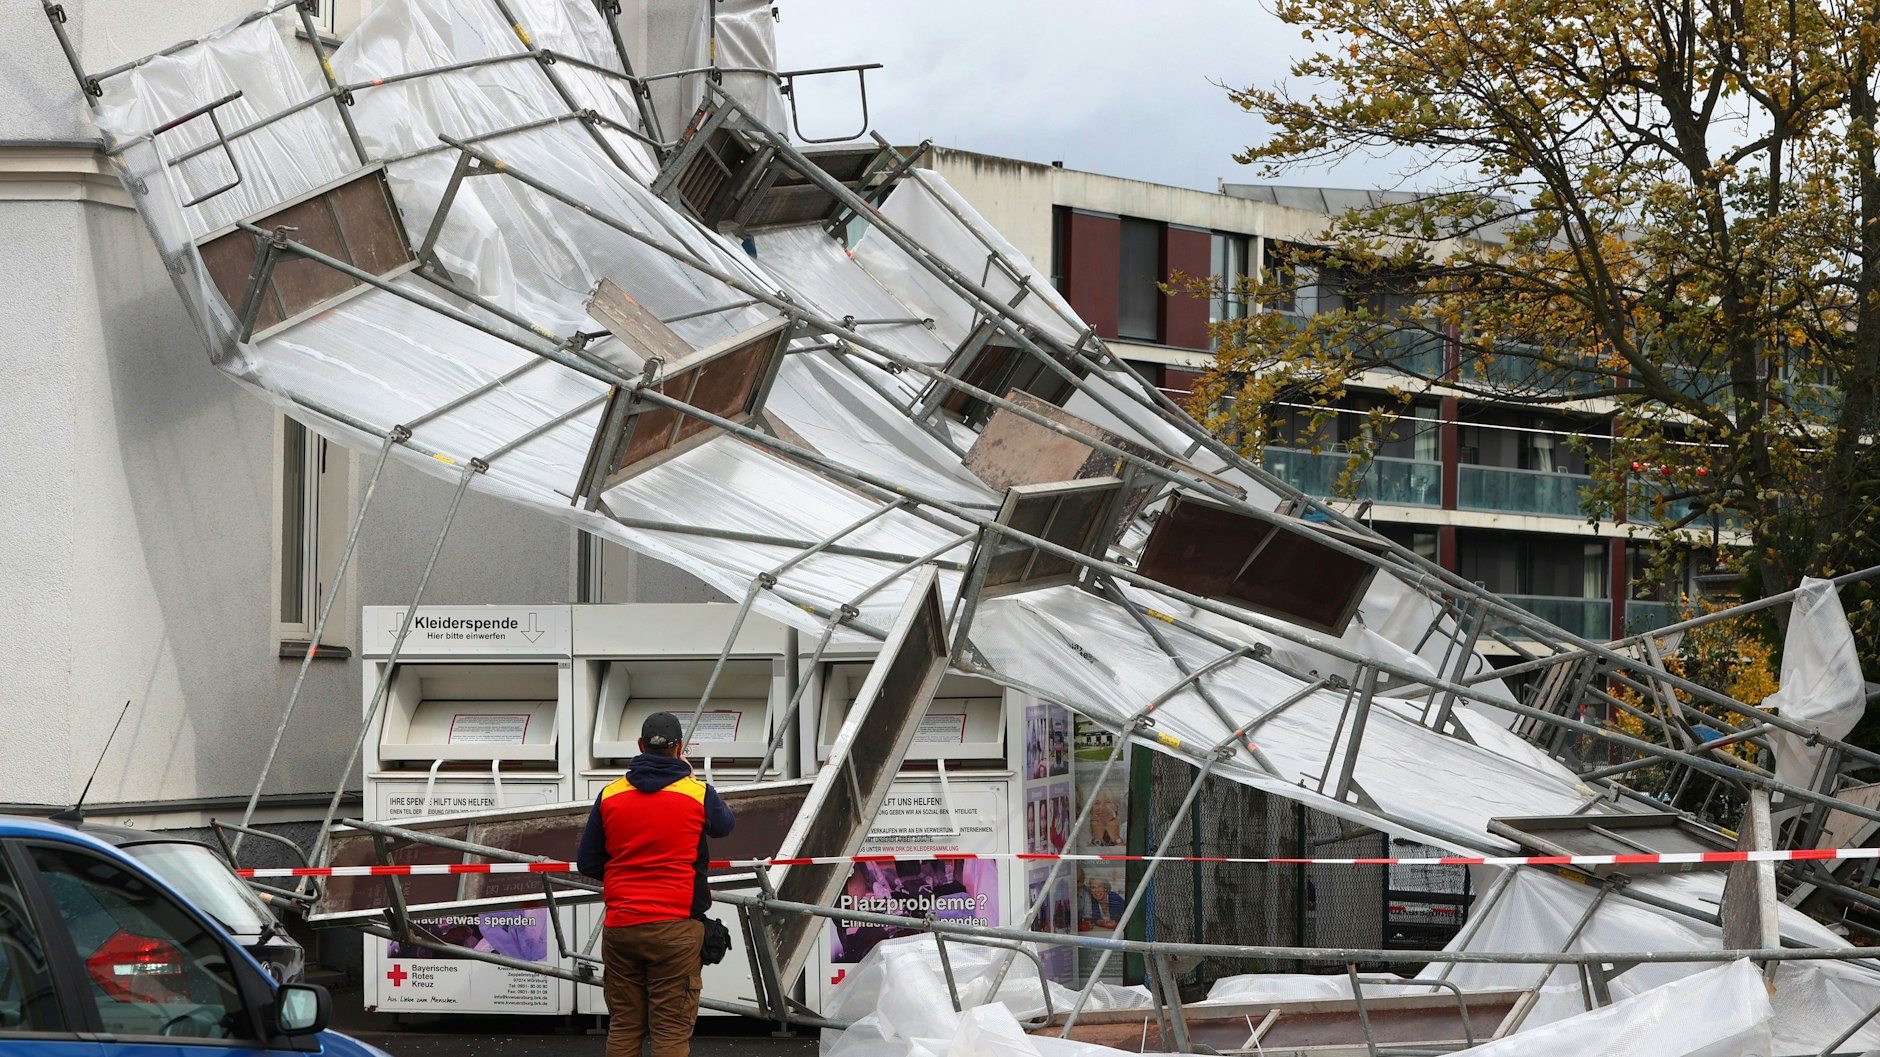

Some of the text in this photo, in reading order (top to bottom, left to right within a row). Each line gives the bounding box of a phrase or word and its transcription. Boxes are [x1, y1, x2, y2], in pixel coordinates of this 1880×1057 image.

[415, 616, 518, 632] Kleiderspende
[427, 632, 506, 640] Hier bitte einwerfen
[390, 798, 405, 806] IHRE
[406, 798, 432, 806] SPEN
[433, 798, 452, 806] HILFT
[452, 798, 466, 806] UNS
[898, 798, 912, 806] UNS
[914, 798, 942, 806] HELFEN!
[840, 894, 988, 914] Platzprobleme?
[446, 914, 481, 926] etwas
[484, 914, 536, 928] spenden
[412, 964, 458, 973] Bayerisches
